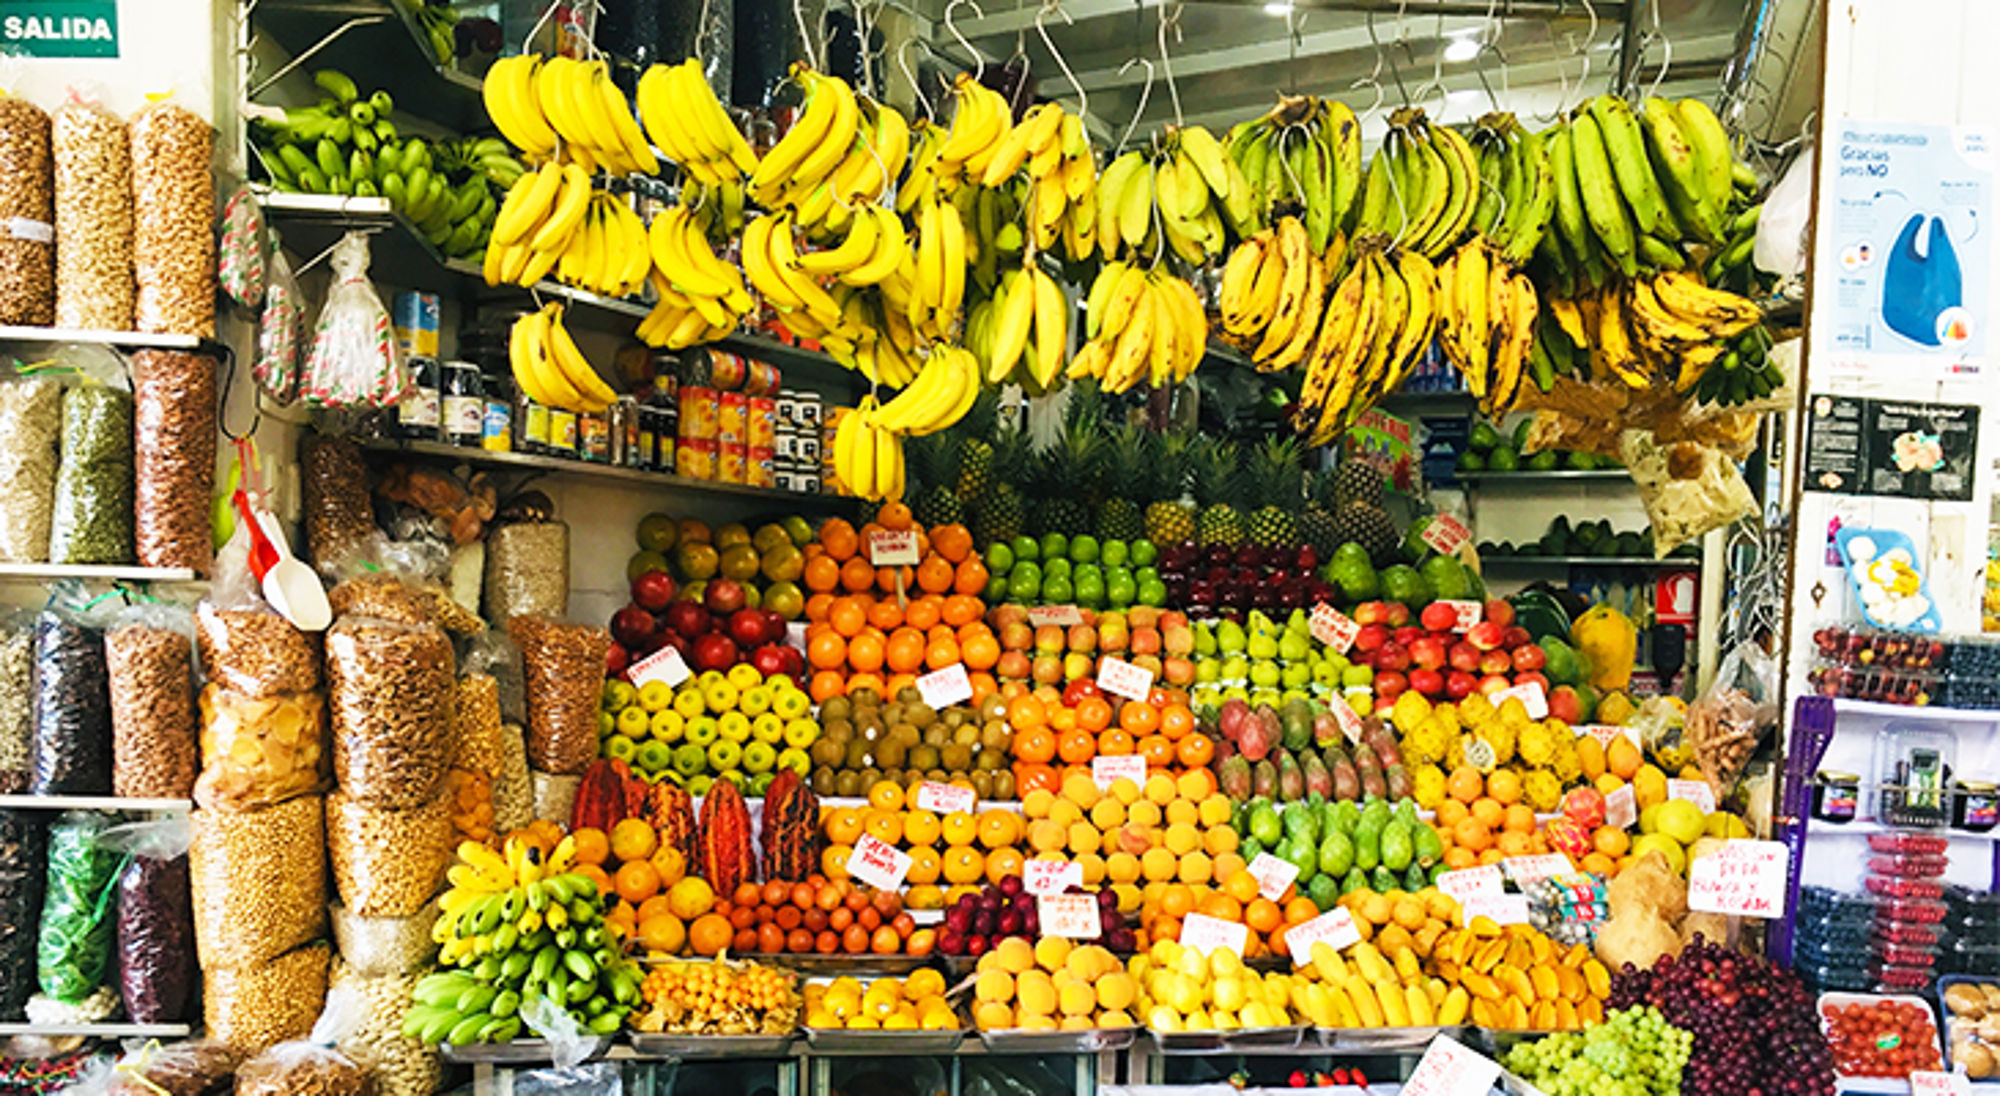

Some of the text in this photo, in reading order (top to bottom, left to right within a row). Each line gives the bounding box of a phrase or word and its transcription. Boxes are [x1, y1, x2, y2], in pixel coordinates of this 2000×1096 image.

[4, 15, 113, 40] SALIDA
[1840, 145, 1890, 162] Gracias
[1867, 163, 1889, 178] NO
